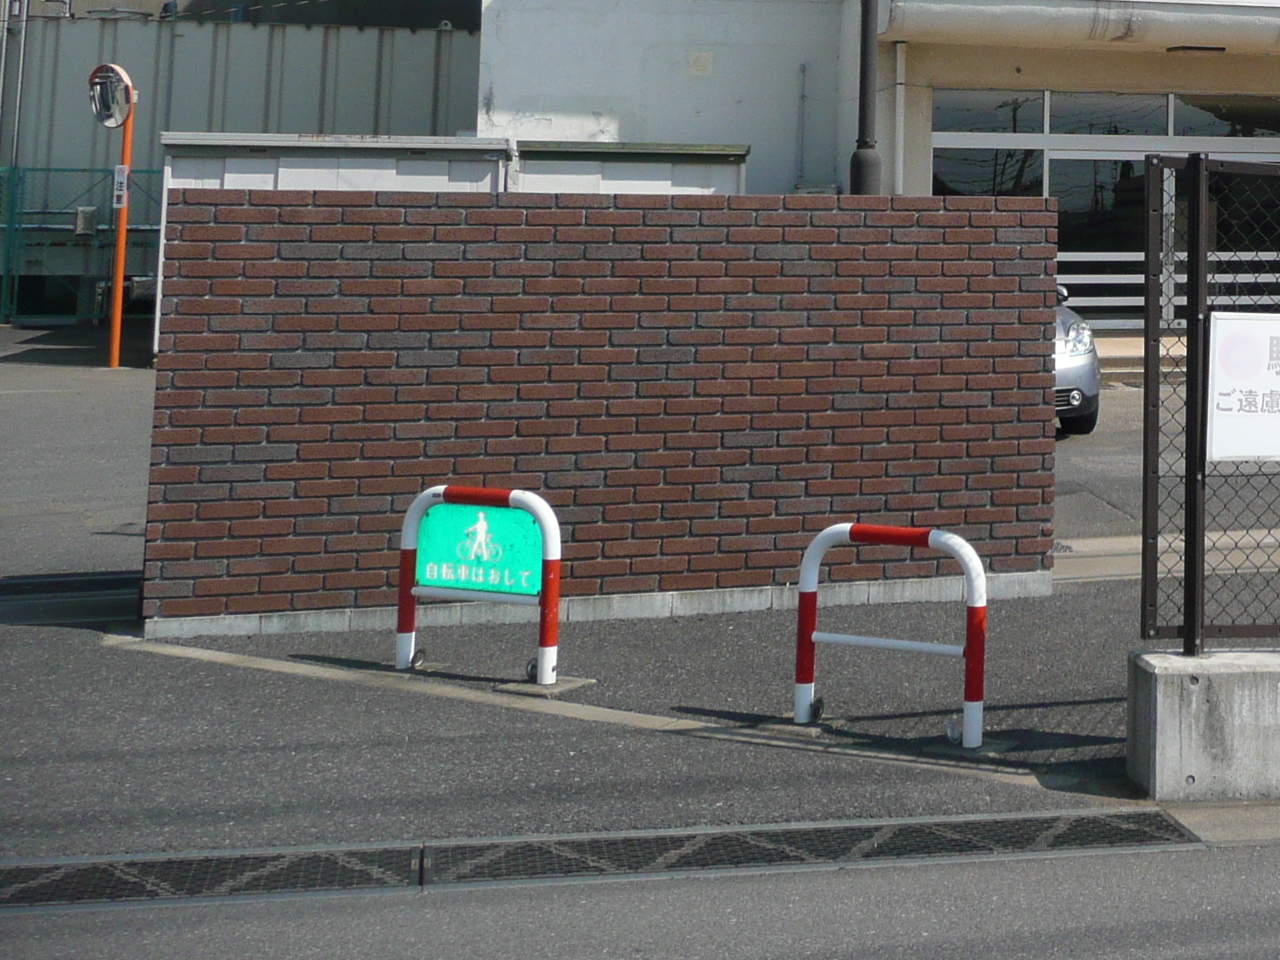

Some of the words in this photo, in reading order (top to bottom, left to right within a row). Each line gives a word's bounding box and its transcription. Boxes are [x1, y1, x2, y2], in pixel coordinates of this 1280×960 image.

[426, 562, 532, 588] 自転車はおして
